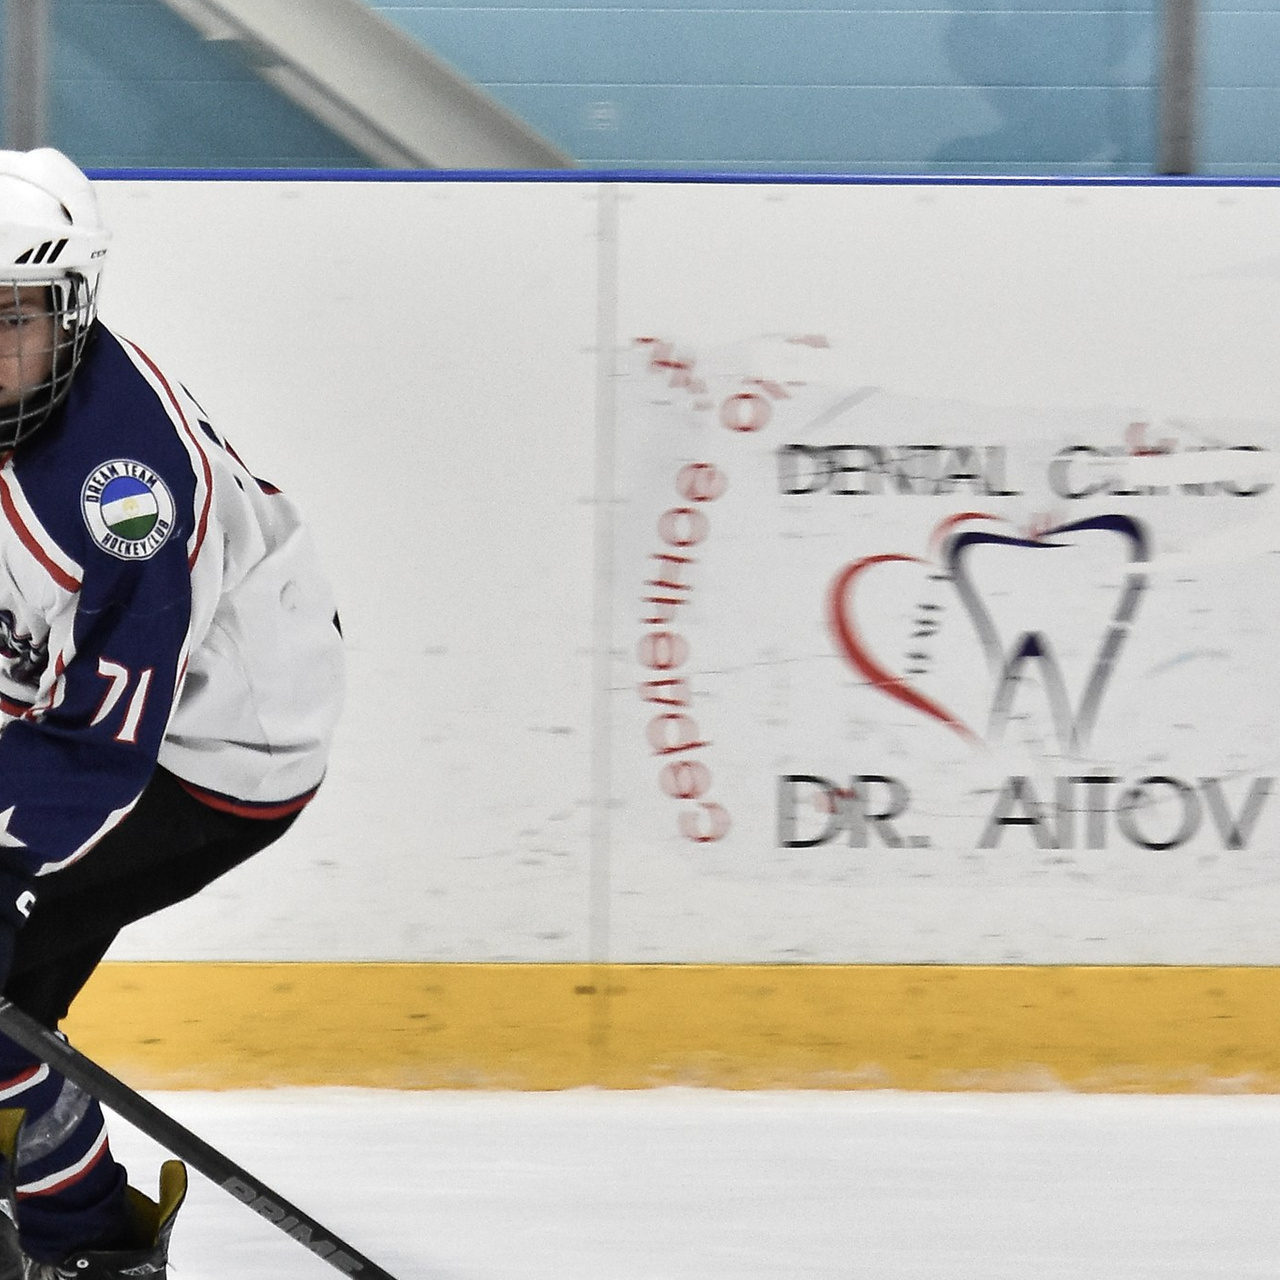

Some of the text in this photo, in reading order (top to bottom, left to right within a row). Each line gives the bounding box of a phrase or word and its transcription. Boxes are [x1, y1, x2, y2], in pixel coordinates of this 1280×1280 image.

[85, 463, 158, 504] DREAM TEAM
[776, 443, 1023, 496] DENTAL
[87, 655, 154, 744] 71
[775, 774, 1277, 851] DR. AITOV
[220, 1175, 365, 1274] PRIME
